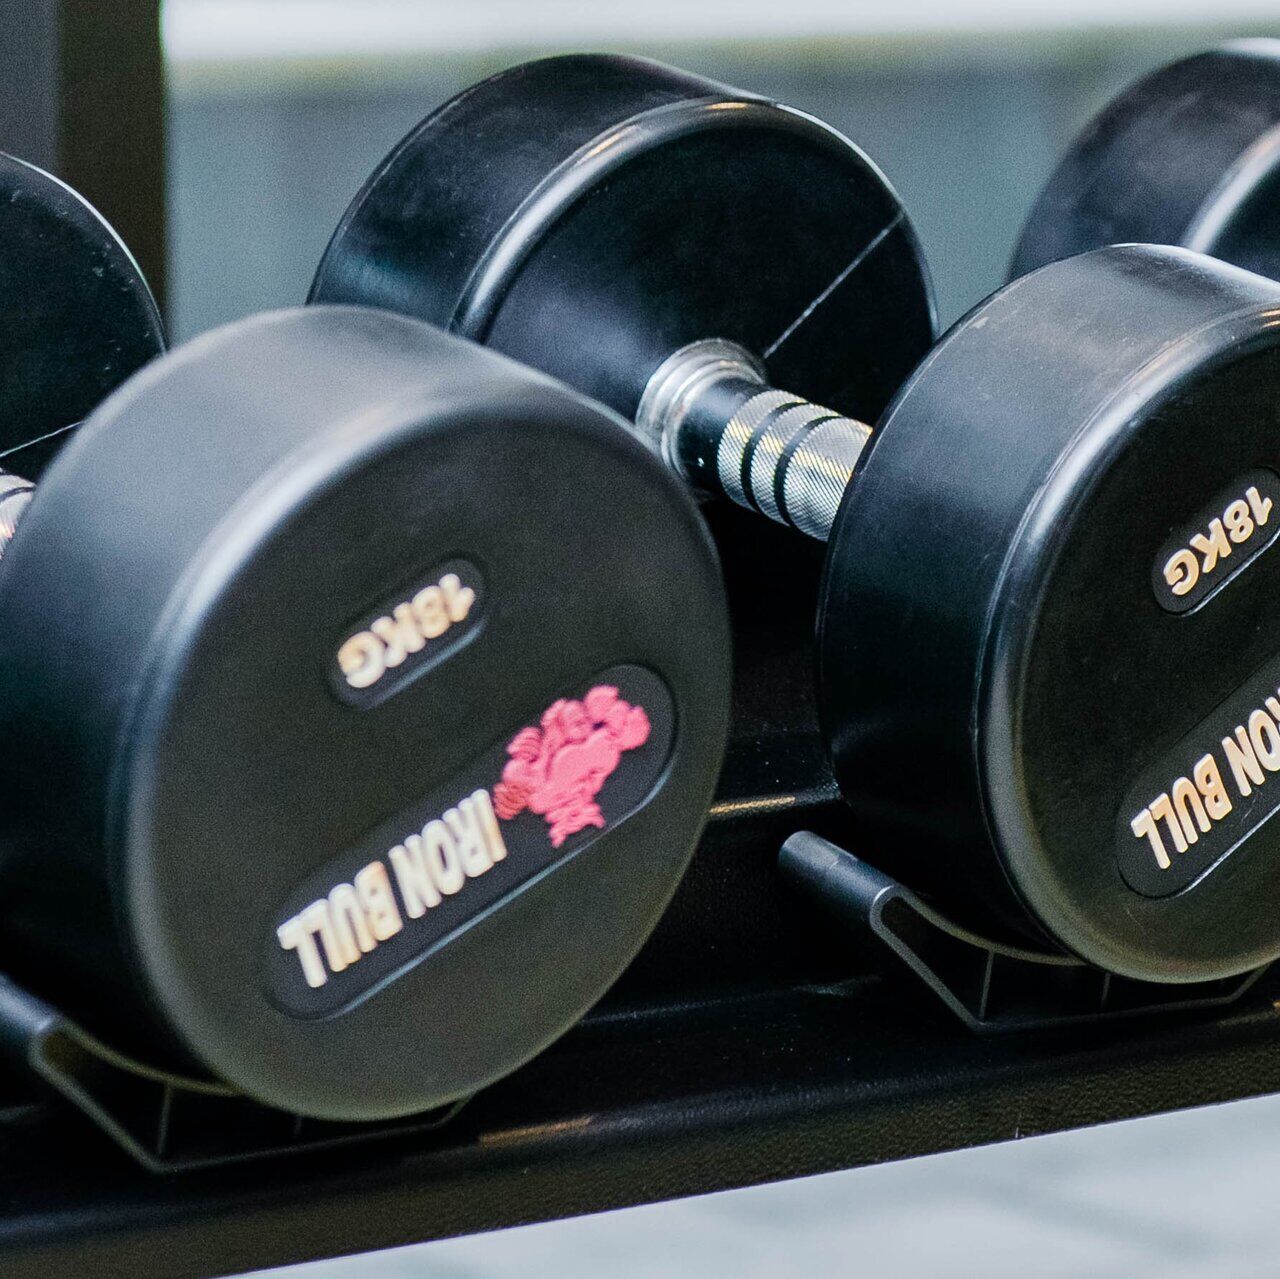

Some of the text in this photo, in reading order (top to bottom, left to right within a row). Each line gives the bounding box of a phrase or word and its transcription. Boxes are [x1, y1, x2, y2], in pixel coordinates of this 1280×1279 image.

[1163, 486, 1273, 596] 18KG
[337, 573, 475, 688] 18KG
[1130, 753, 1233, 870] BULL
[276, 788, 508, 988] IRON BULL
